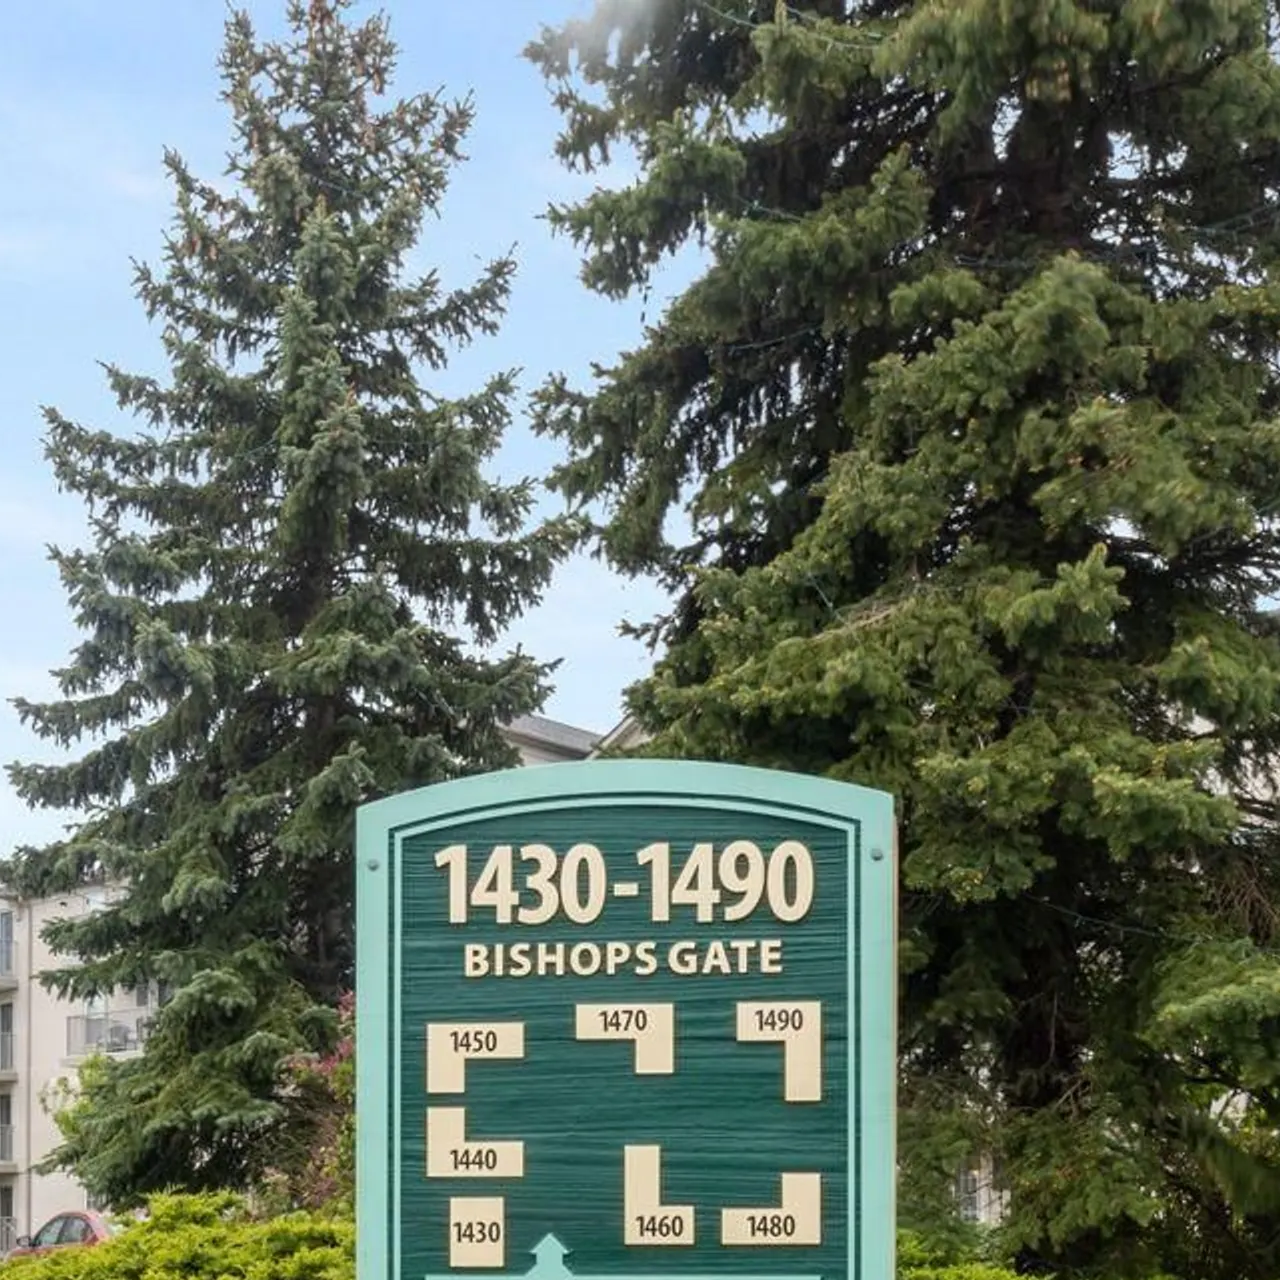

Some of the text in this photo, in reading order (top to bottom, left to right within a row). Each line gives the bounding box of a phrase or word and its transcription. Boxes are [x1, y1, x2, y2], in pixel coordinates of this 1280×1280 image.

[434, 840, 815, 925] 1430-1490
[464, 939, 783, 978] BISHOPS GATE
[599, 1010, 647, 1032] 1470
[755, 1009, 803, 1031] 1490
[450, 1031, 497, 1052] 1450
[450, 1149, 497, 1170] 1440
[453, 1222, 501, 1243] 1430
[636, 1215, 684, 1237] 1460
[747, 1215, 796, 1237] 1480
